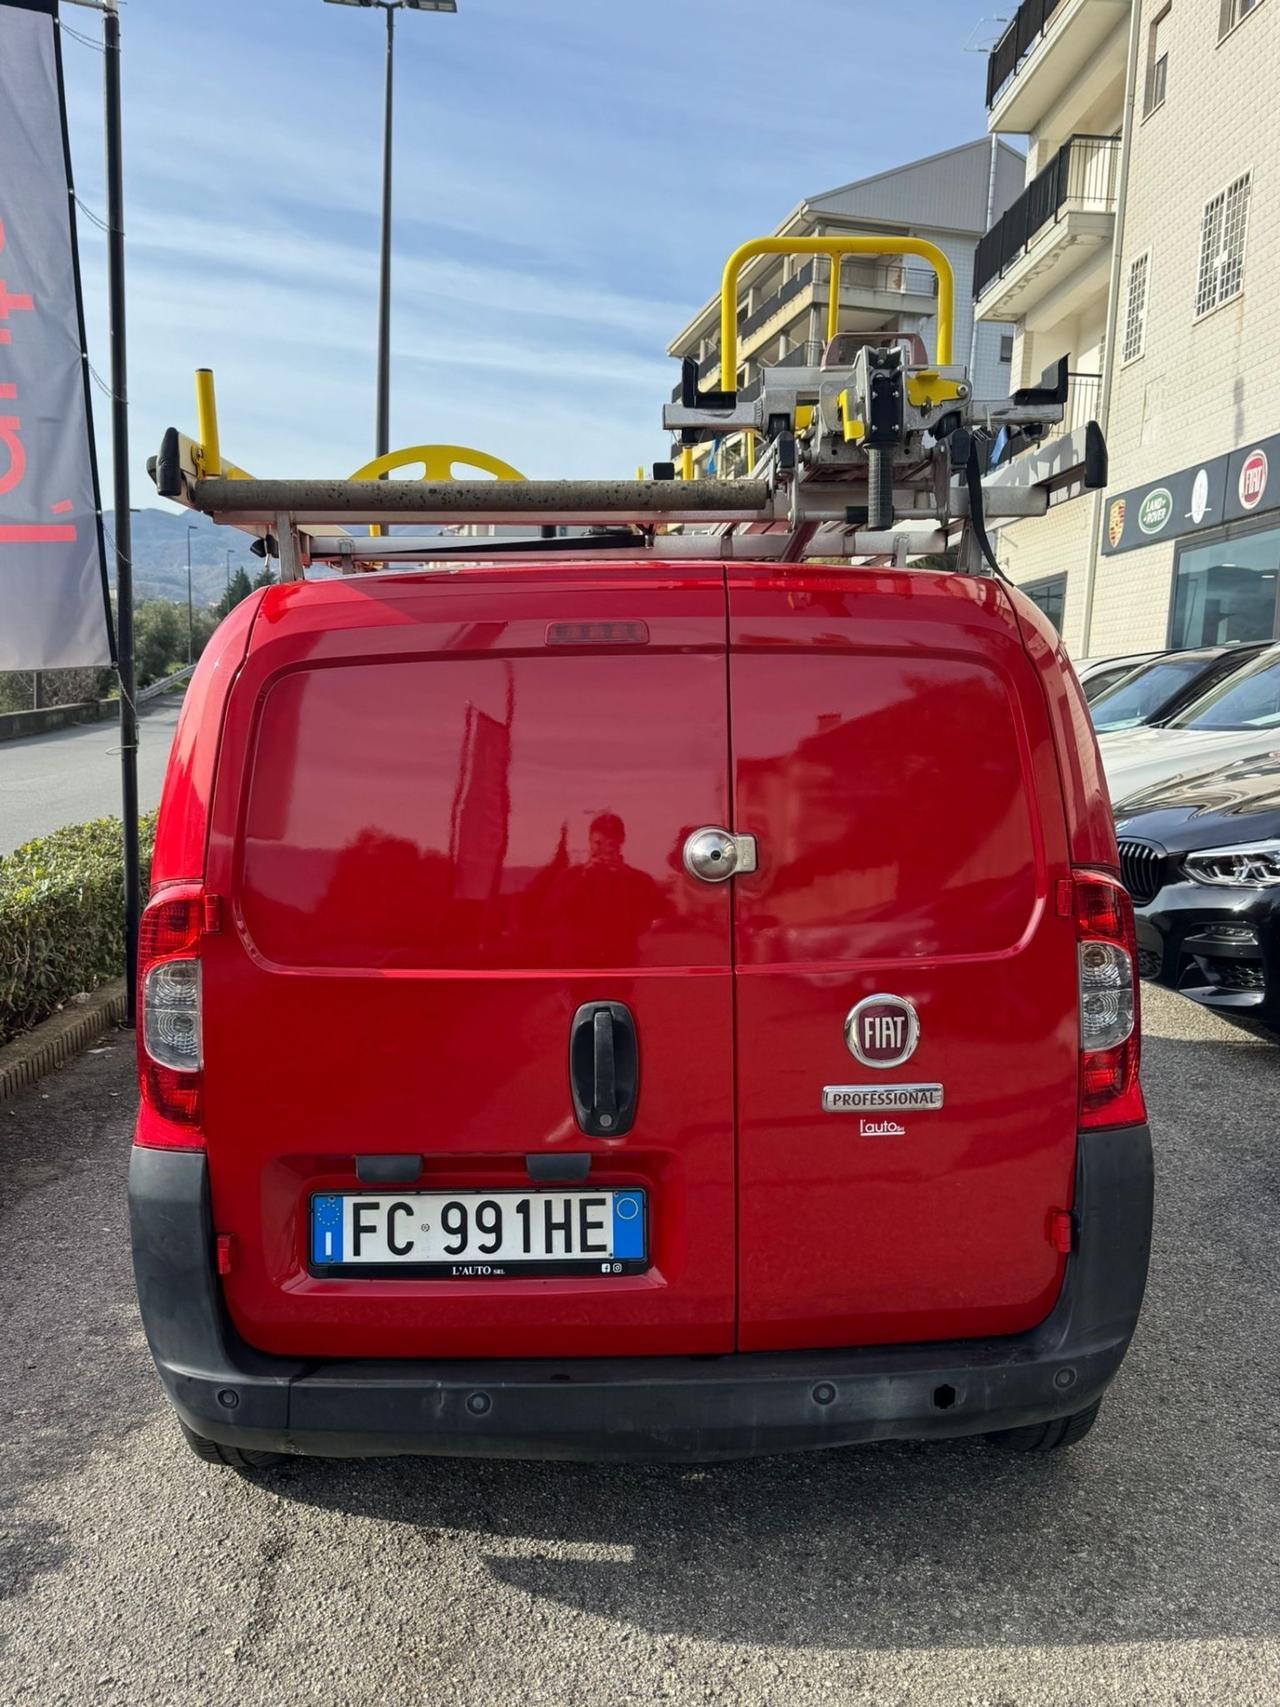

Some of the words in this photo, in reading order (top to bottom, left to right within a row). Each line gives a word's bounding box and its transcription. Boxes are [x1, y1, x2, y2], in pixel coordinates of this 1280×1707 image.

[1246, 466, 1263, 494] FIAT
[864, 1016, 905, 1049] FIAT
[833, 1092, 936, 1105] PROFESSIONAL
[352, 1201, 415, 1257] FC
[440, 1197, 608, 1256] 991HE
[452, 1266, 492, 1275] L'AUTO
